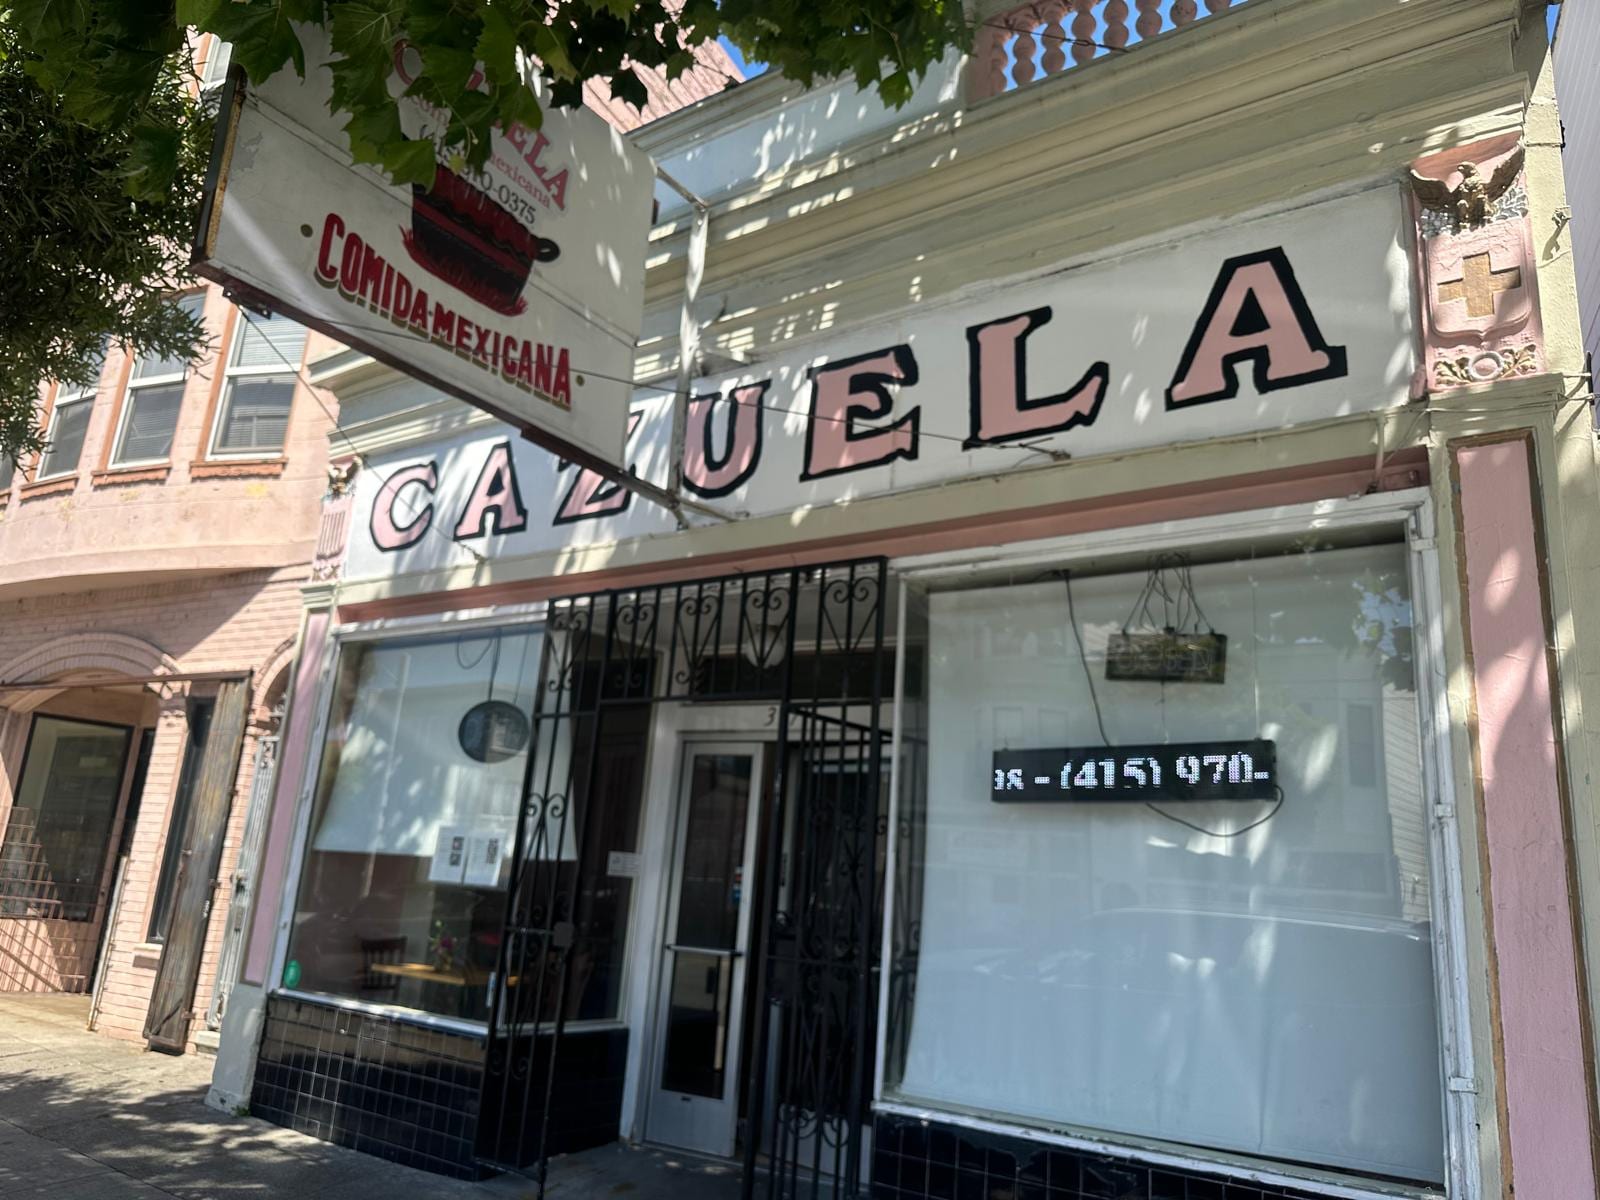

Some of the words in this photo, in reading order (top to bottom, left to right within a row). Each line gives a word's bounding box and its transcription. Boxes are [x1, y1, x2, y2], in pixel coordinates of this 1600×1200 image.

[393, 38, 569, 211] CELA
[430, 301, 572, 412] MEXICANA
[1060, 757, 1162, 790] (415)
